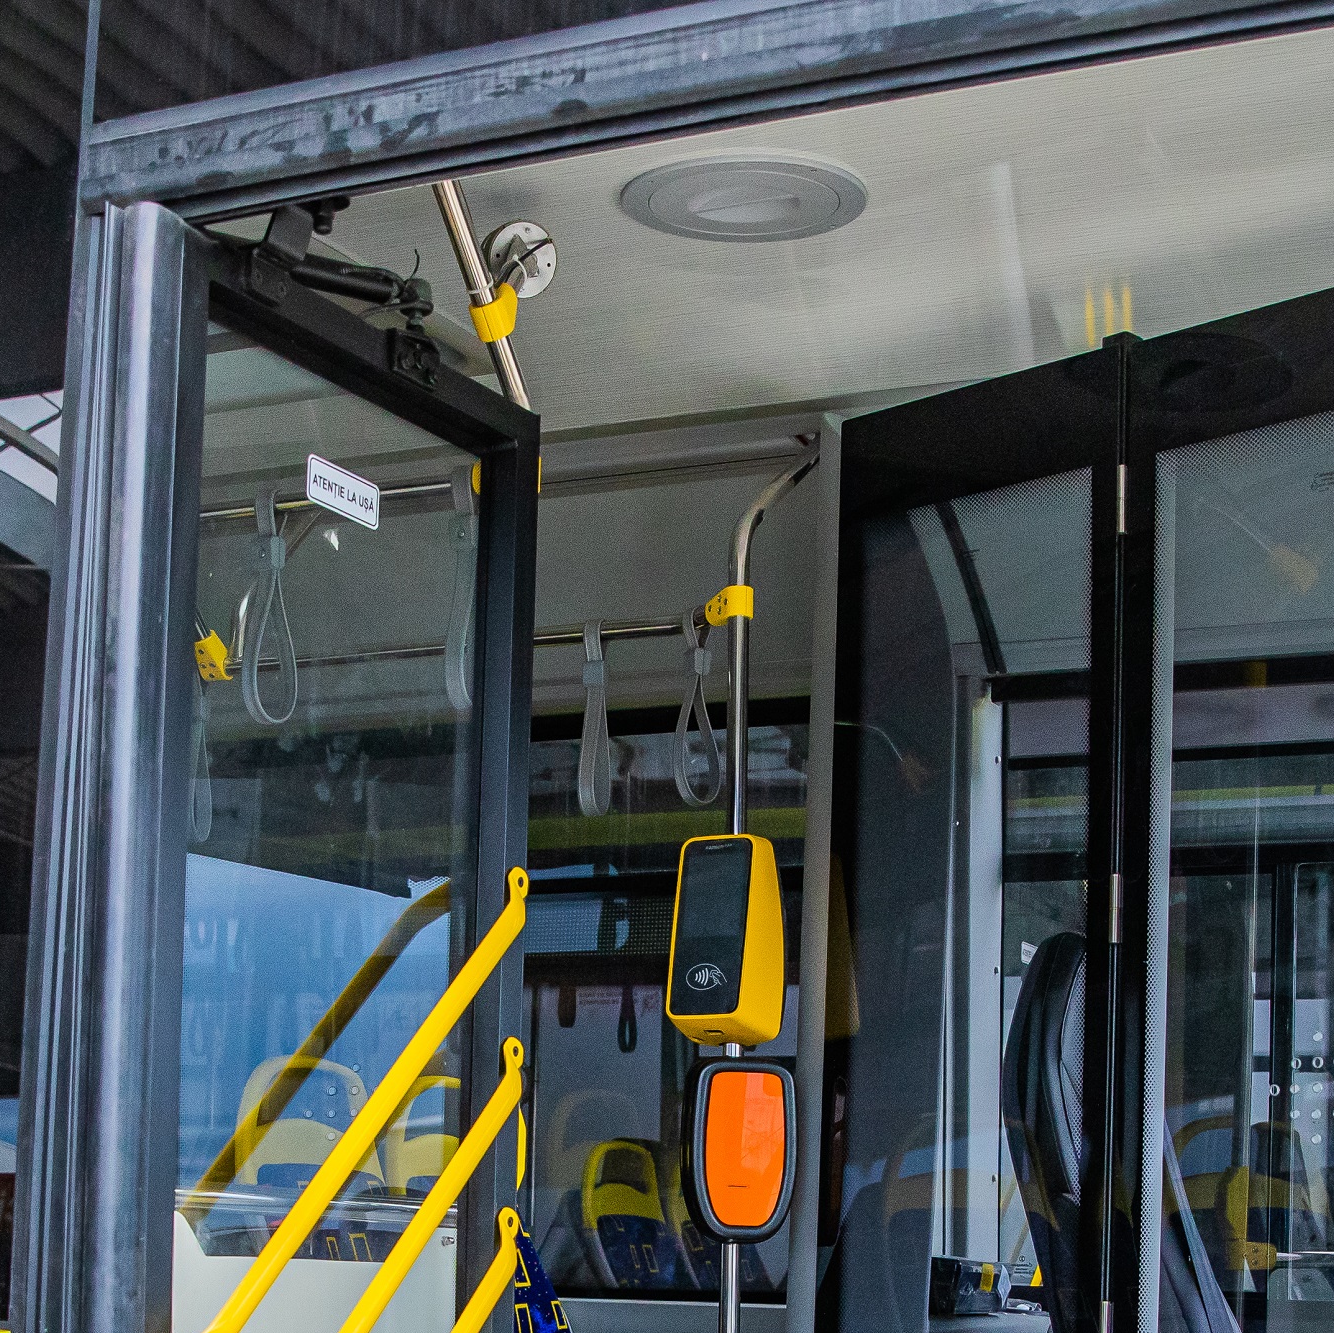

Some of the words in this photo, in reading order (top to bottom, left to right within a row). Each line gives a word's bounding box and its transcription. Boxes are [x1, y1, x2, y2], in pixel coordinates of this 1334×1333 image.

[313, 474, 345, 499] ATENȚIE
[347, 489, 357, 505] LA
[359, 495, 374, 513] UȘĂ
